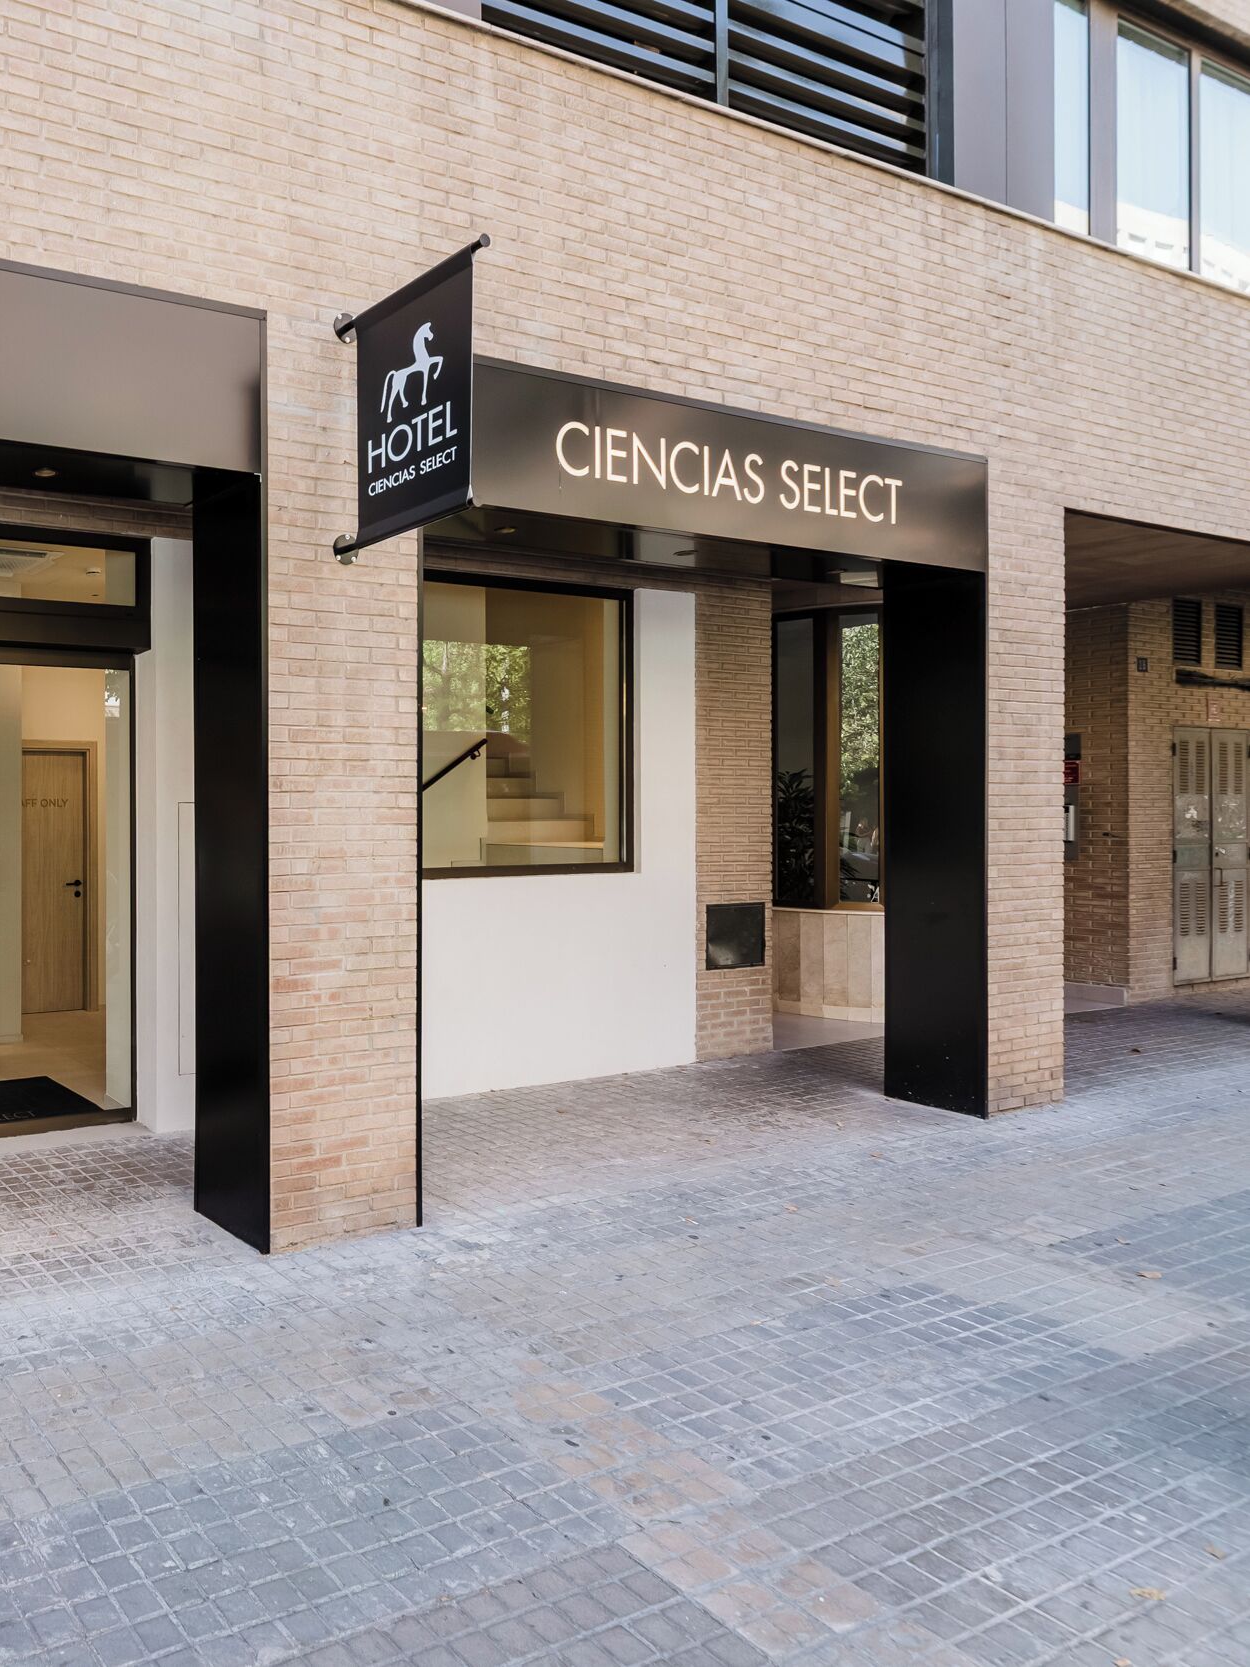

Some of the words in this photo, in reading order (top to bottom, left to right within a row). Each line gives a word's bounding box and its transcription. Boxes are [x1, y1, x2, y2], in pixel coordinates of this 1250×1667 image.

[367, 400, 458, 474] HOTEL
[368, 465, 416, 497] CIENCIAS
[419, 446, 458, 475] SELECT
[555, 421, 765, 504] CIENCIAS
[779, 460, 903, 525] SELECT
[40, 798, 69, 808] ONLY
